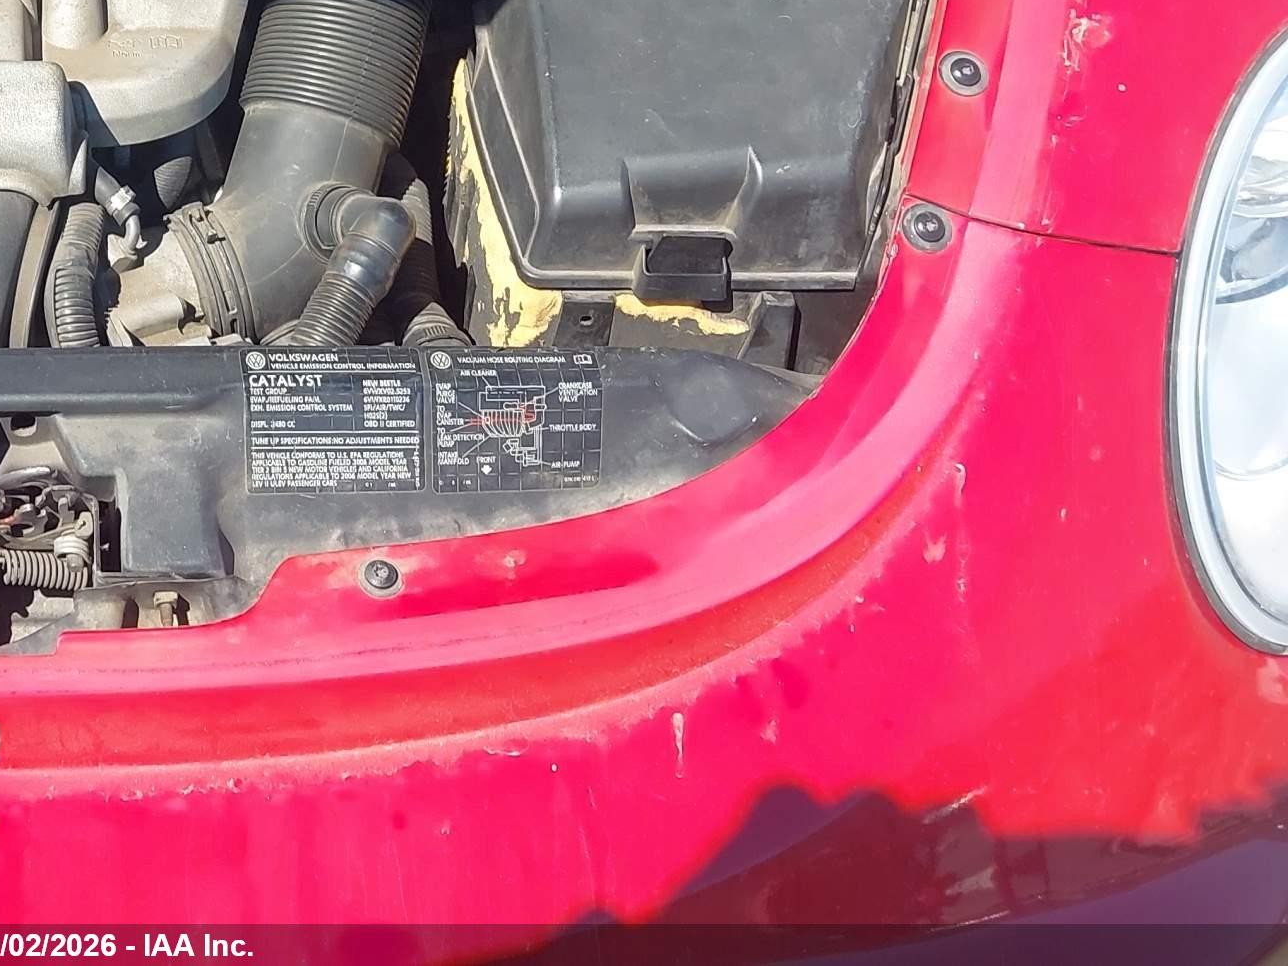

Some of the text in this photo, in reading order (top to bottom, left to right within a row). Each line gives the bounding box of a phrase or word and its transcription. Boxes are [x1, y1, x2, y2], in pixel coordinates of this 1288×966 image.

[268, 353, 339, 362] VOLKSWAGEN
[248, 374, 323, 387] CATALYST
[362, 379, 401, 387] NEW BEETLE
[250, 387, 288, 395] TEST GROUP
[435, 389, 455, 397] PURGE
[436, 396, 455, 404] VALVE
[266, 404, 296, 412] EMISSION
[297, 404, 326, 412] CONTROL
[327, 404, 354, 412] SYSTEM
[363, 420, 379, 428] OBD
[385, 420, 416, 428] CERTIFIED
[436, 418, 464, 426] CANISTER
[250, 436, 269, 445] TUNE
[269, 436, 280, 445] UP
[345, 436, 393, 445] ADJUSTMENTS
[394, 436, 420, 445] NEEDED
[250, 451, 265, 459] THIS
[265, 451, 290, 459] VEHICLE
[291, 451, 326, 459] CONFORMS
[326, 451, 336, 459] TO
[349, 451, 362, 459] EPA
[362, 451, 404, 459] REGULATIONS
[437, 458, 470, 466] MANIFOLD
[476, 456, 497, 464] FRONT
[252, 480, 264, 488] LEV
[287, 480, 321, 488] PASSENGER
[321, 480, 338, 488] CARS
